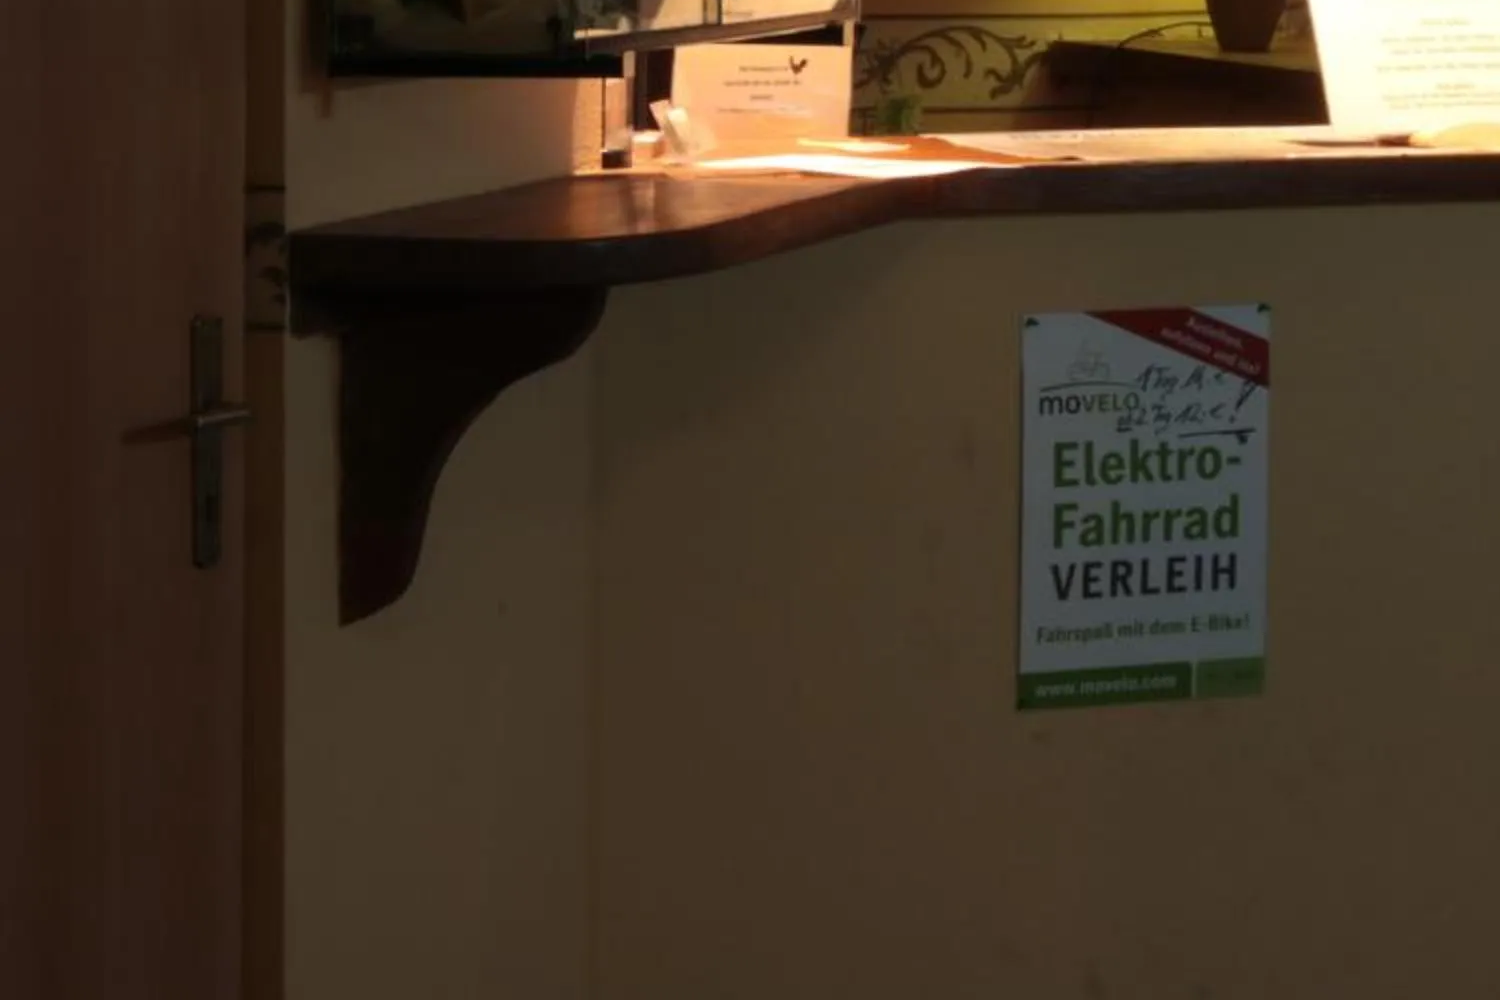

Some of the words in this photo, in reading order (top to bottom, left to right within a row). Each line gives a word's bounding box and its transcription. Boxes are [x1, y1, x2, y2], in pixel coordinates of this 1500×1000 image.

[1052, 438, 1243, 489] Elektro-
[1052, 493, 1241, 550] Fahrrad
[1050, 552, 1238, 602] VERLEIH
[1036, 621, 1114, 645] Fahrspaß
[1116, 619, 1145, 638] mit
[1148, 616, 1187, 636] dem
[1190, 612, 1251, 634] E-Bike!
[1033, 672, 1178, 698] www.movelo.com
